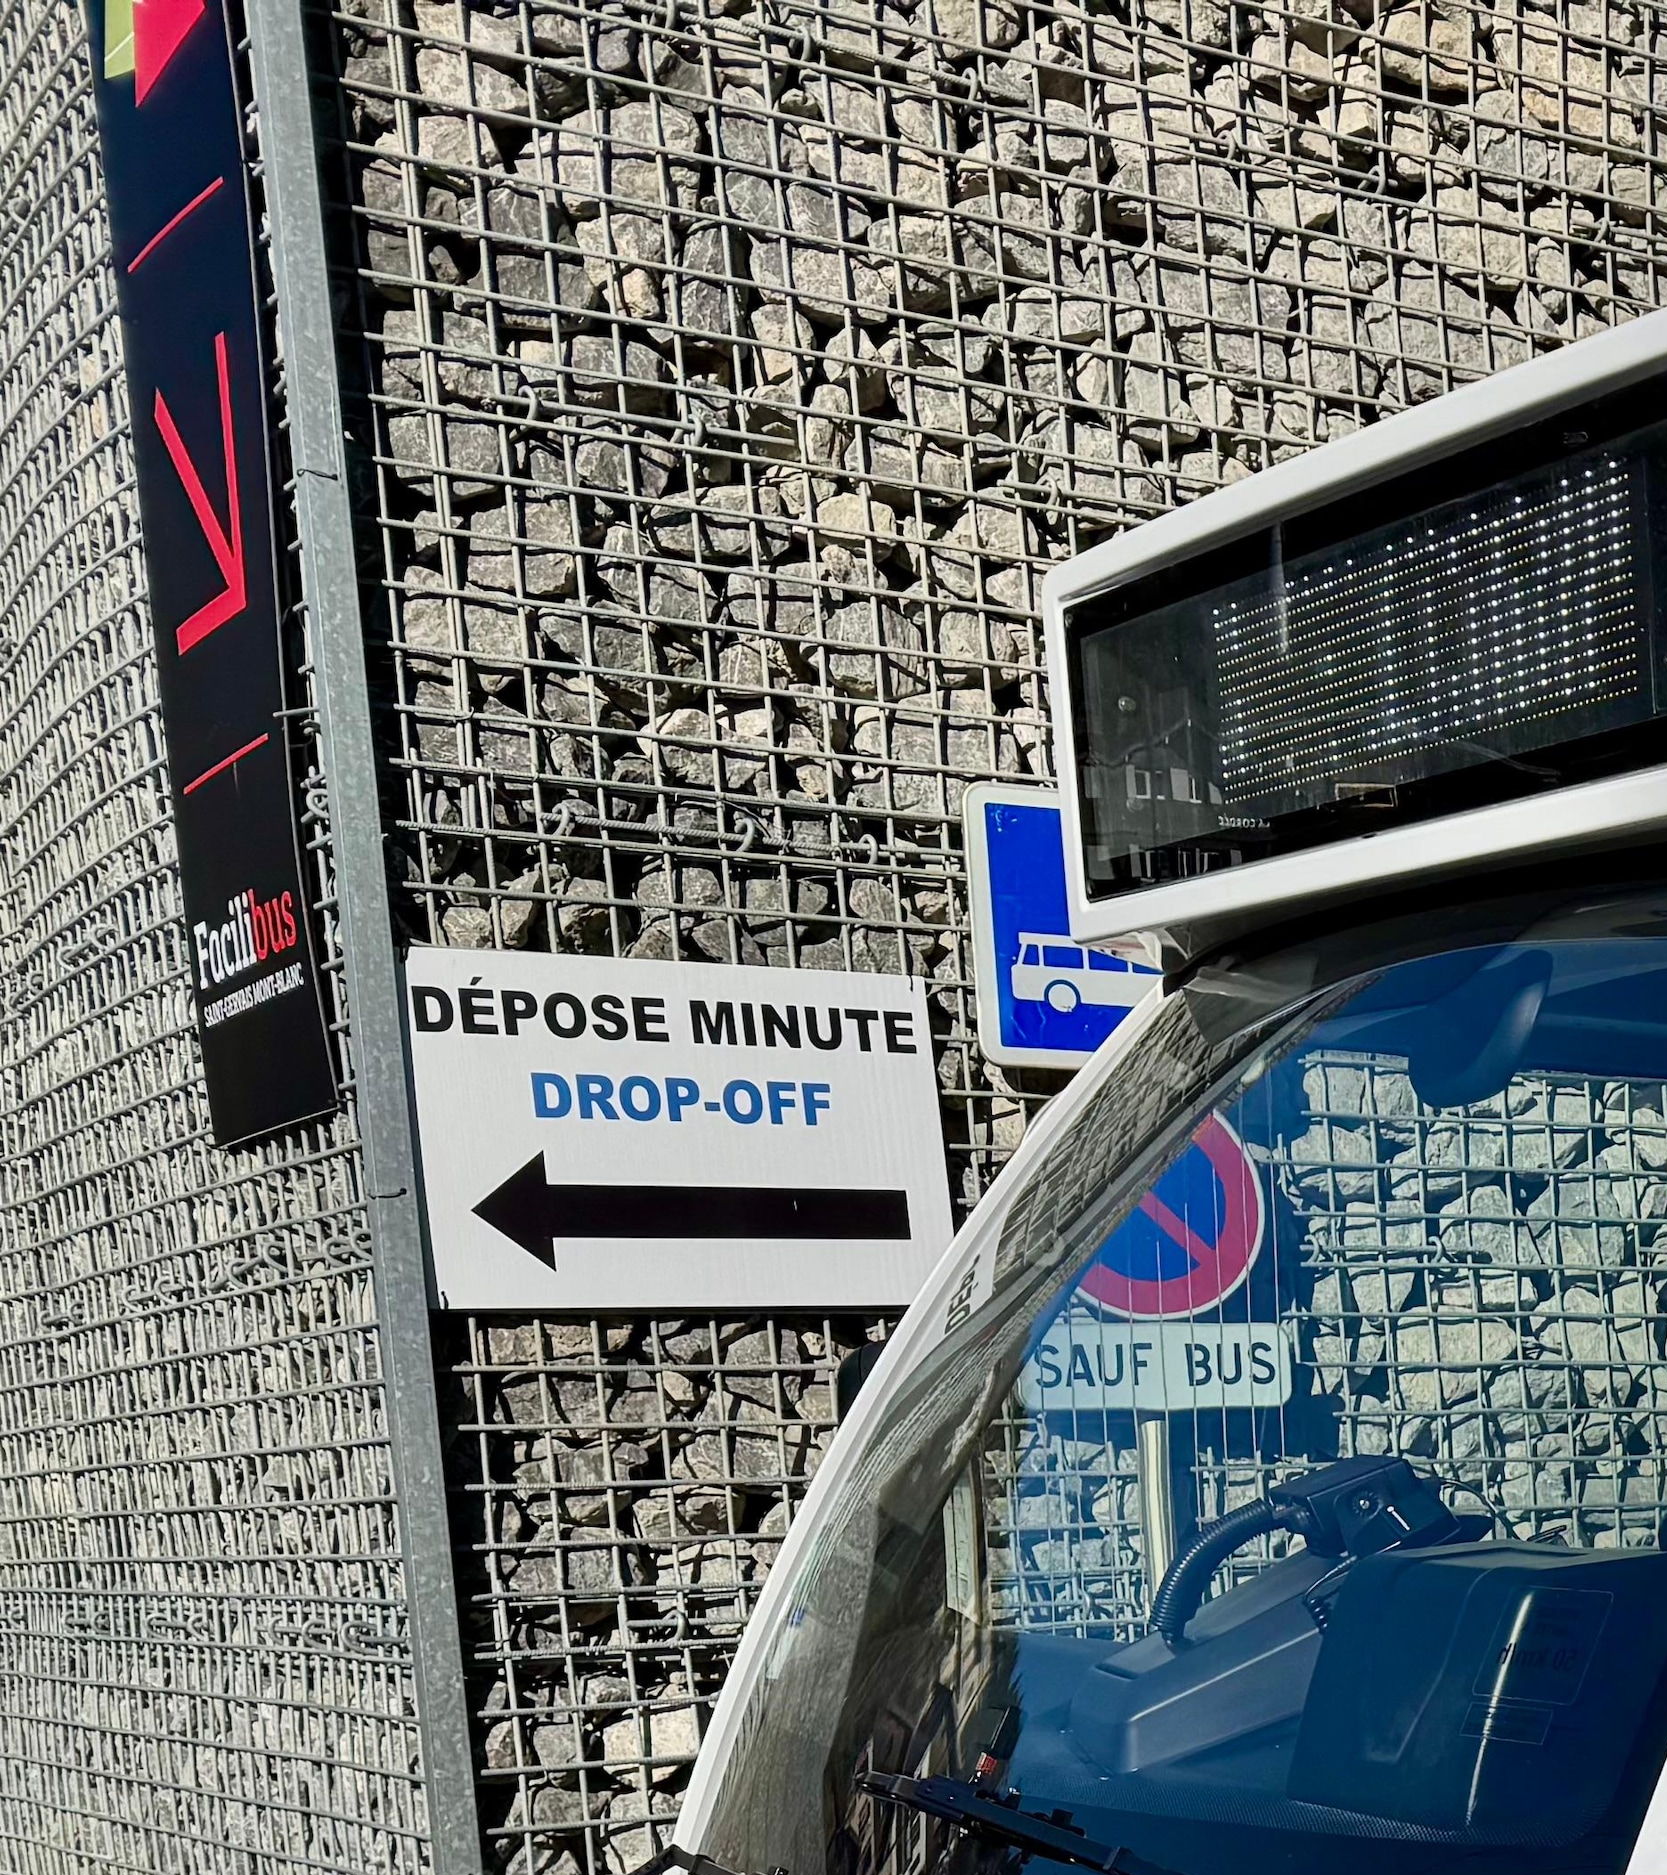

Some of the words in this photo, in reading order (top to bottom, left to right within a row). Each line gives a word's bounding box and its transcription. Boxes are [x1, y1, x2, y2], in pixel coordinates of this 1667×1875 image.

[194, 888, 297, 990] Facilibus
[204, 987, 254, 1028] SAINT-GERVAIS
[252, 962, 304, 1006] MONT-BLANC
[411, 976, 670, 1042] DÉPOSE
[690, 999, 918, 1054] MINUTE
[530, 1072, 831, 1126] DROP-OFF
[1034, 1342, 1153, 1389] SAUF
[1184, 1342, 1276, 1387] BUS
